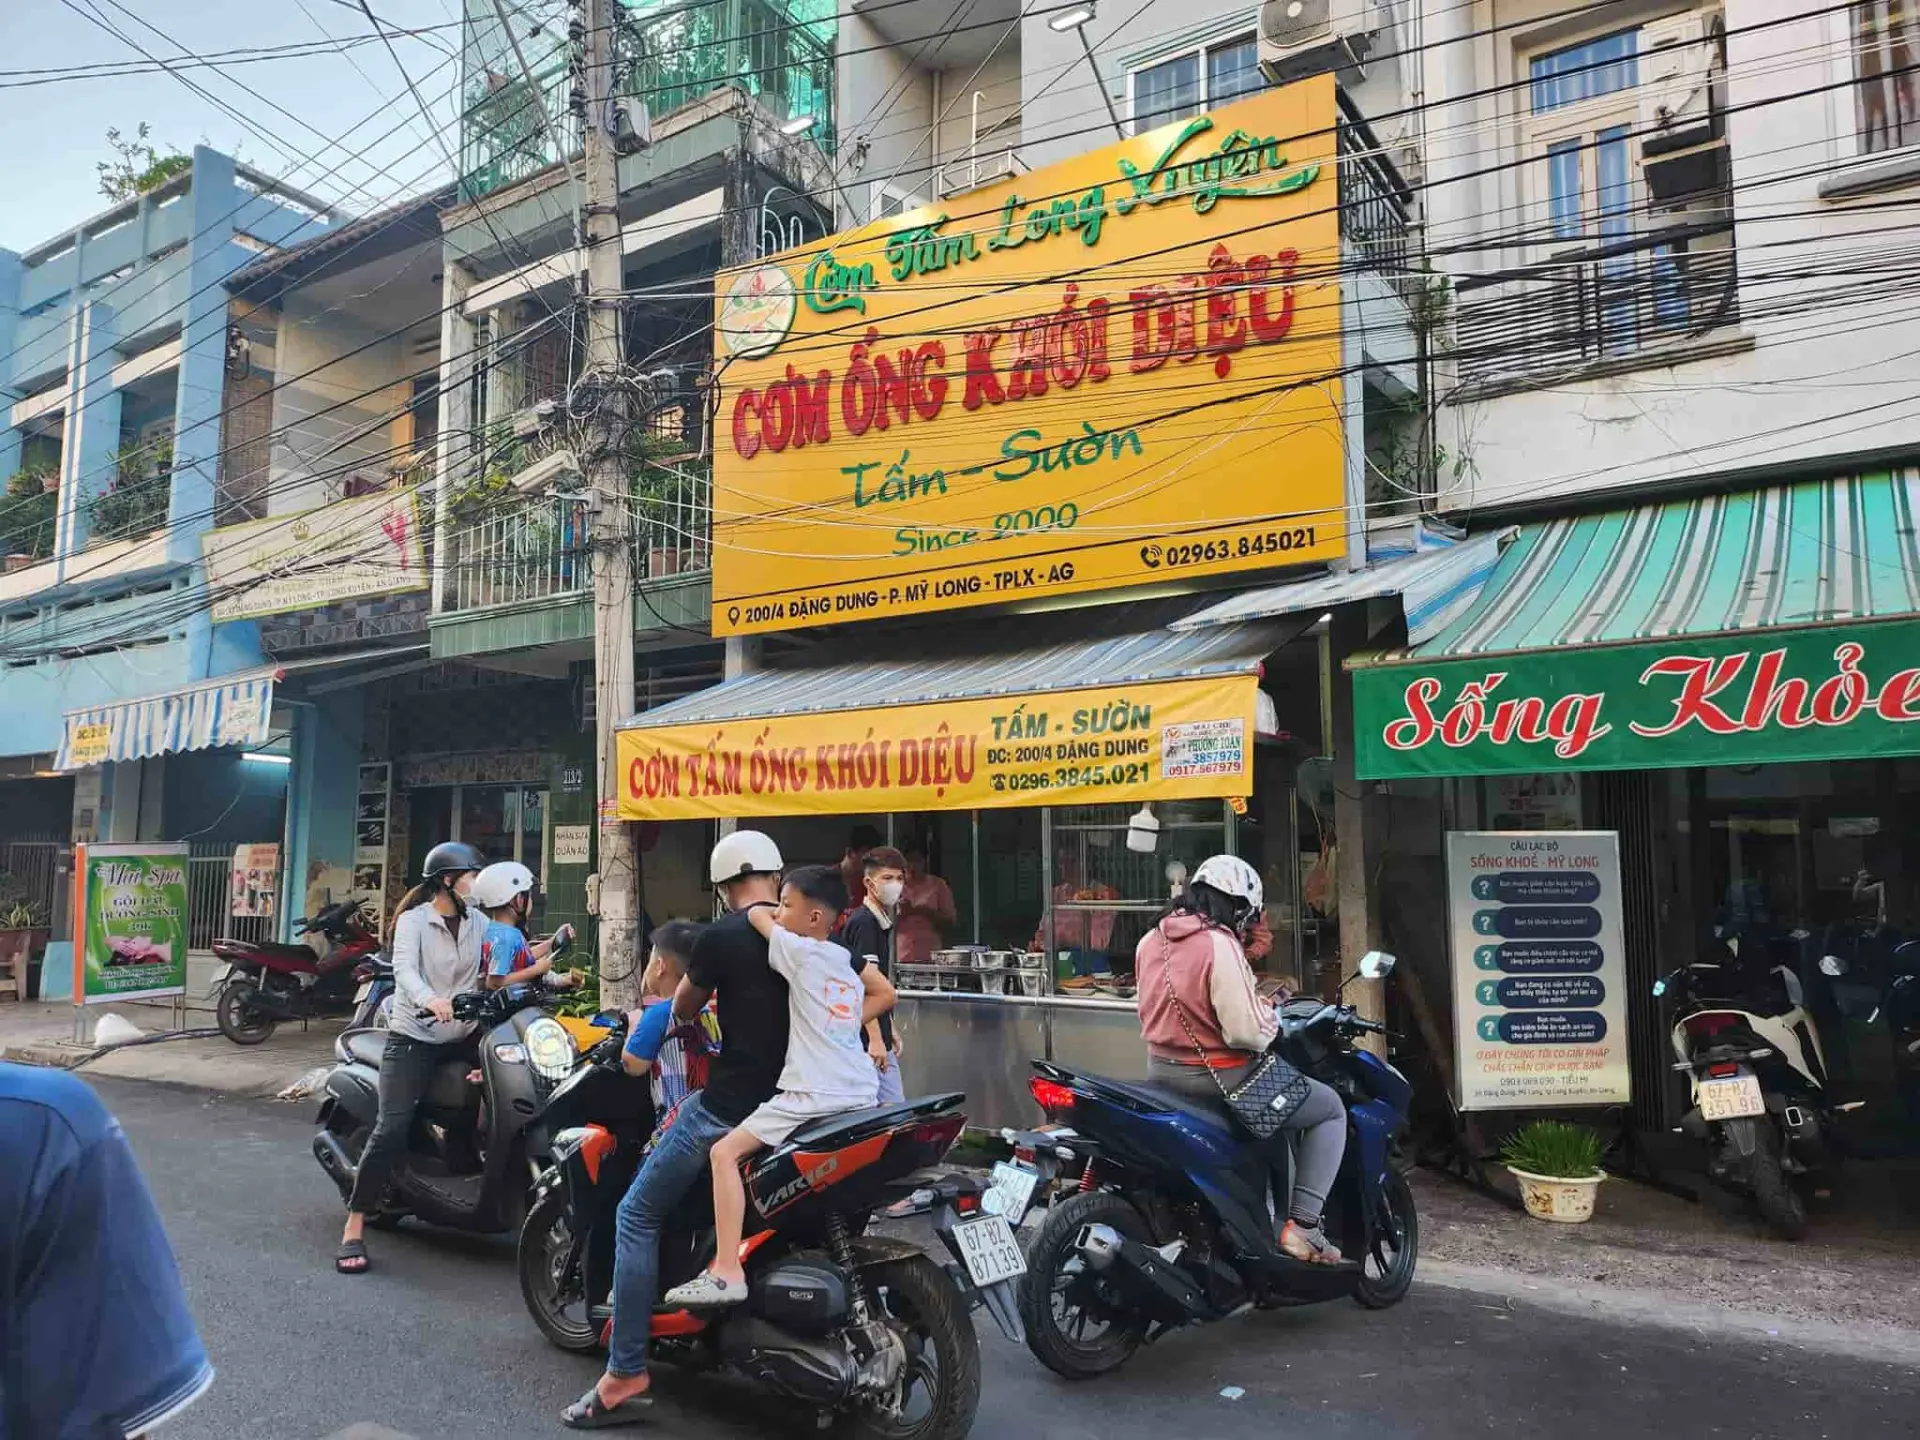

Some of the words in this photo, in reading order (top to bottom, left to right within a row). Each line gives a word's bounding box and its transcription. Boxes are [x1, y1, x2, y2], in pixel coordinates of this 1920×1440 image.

[885, 212, 981, 281] Tấm
[988, 186, 1107, 252] Long
[1115, 117, 1320, 215] Xuyên
[732, 363, 832, 460] CƠM
[842, 326, 948, 435] ỐNG
[962, 283, 1110, 411] KHÓI
[1129, 242, 1300, 379] DIỆU
[840, 449, 948, 508] Tấm
[994, 421, 1142, 481] Sườn
[892, 526, 980, 556] Since
[992, 502, 1078, 540] 2000
[1166, 527, 1316, 566] 02963.845021
[745, 604, 784, 623] 200/4
[789, 597, 831, 620] ĐẶNG
[836, 591, 878, 611] DUNG
[906, 579, 929, 602] MỸ
[934, 576, 981, 599] LONG
[993, 568, 1035, 591] TPLX
[1048, 562, 1075, 583] AG
[991, 703, 1048, 740] TẤM
[1072, 698, 1151, 735] SƯỜN
[1384, 672, 1612, 758] Sống
[1628, 642, 1920, 737] Khỏe
[629, 747, 680, 799] CƠM
[685, 729, 742, 798] TẤM
[750, 726, 807, 793] ỐNG
[816, 727, 890, 791] KHÓI
[899, 720, 977, 798] DIỆU
[987, 748, 1011, 765] ĐC:
[1015, 746, 1052, 762] 200/4
[1056, 741, 1102, 765] ĐẶNG
[1105, 739, 1148, 756] DUNG
[1192, 750, 1241, 765] 3857979
[1009, 762, 1149, 791] 0296.3845.021
[1470, 853, 1503, 868] SỐNG
[1548, 854, 1566, 868] MỸ
[1568, 856, 1600, 869] LONG
[1510, 839, 1527, 851] CÂU
[144, 864, 184, 890] Spa
[754, 1155, 839, 1215] VARIO
[963, 1220, 1006, 1252] 67-B2
[971, 1245, 1020, 1280] 871.39
